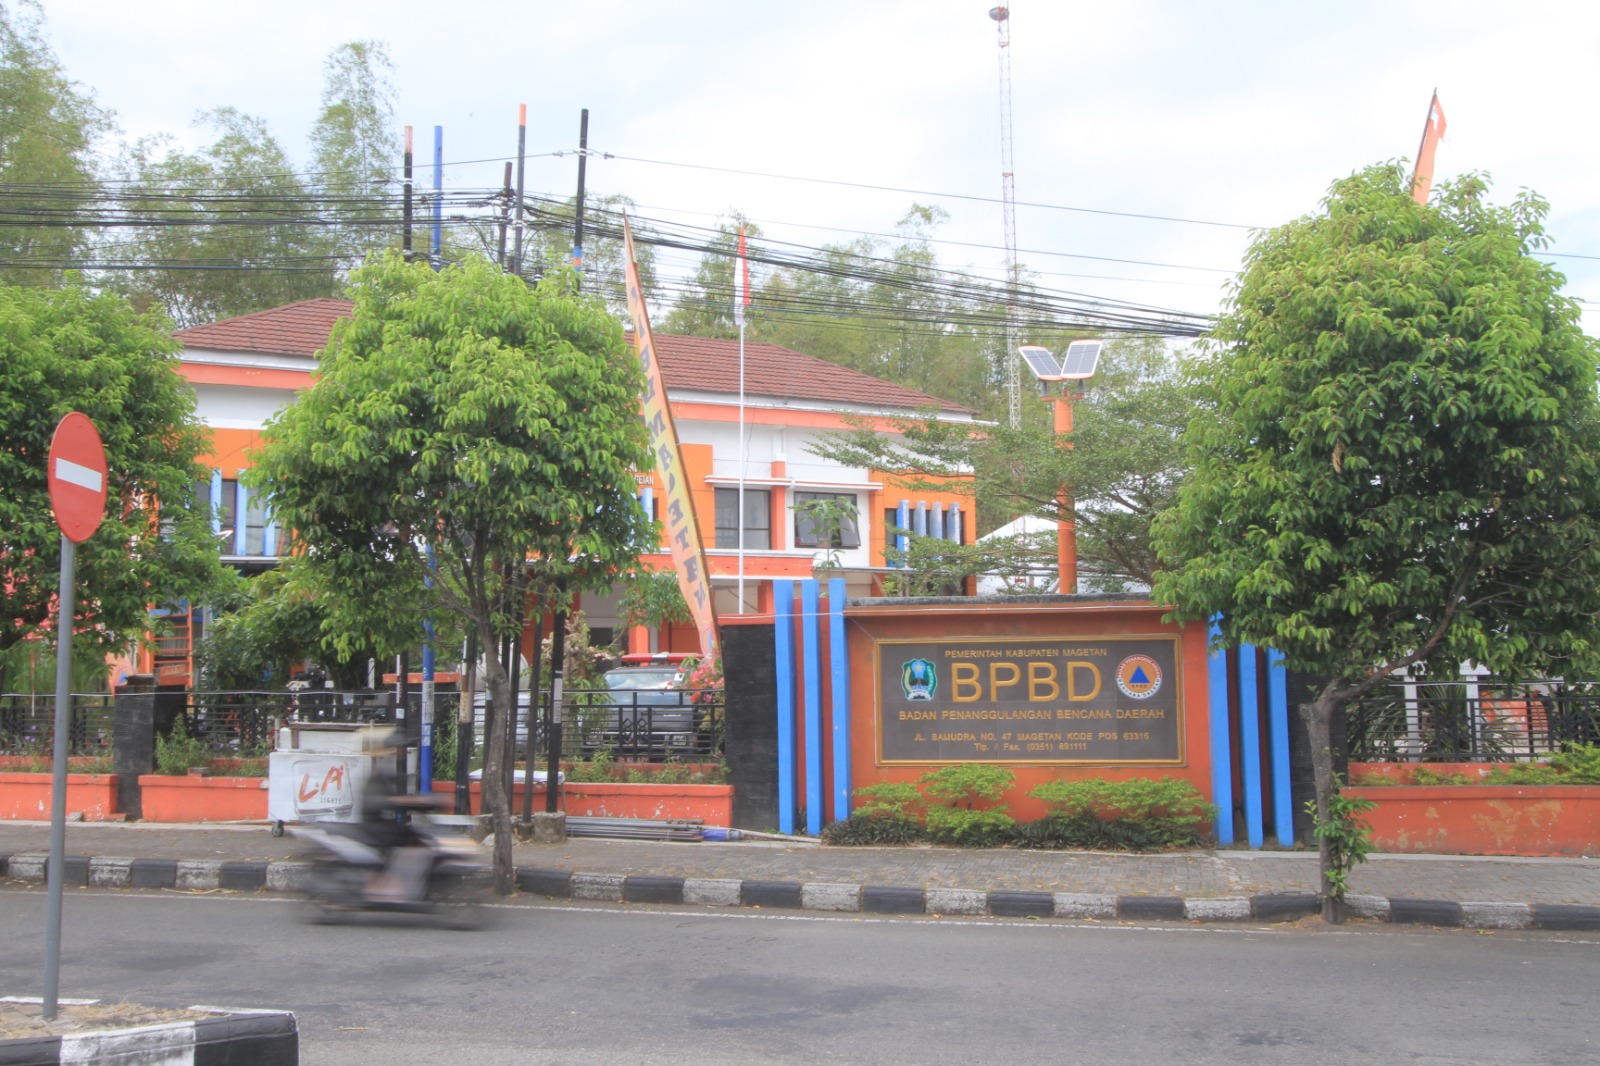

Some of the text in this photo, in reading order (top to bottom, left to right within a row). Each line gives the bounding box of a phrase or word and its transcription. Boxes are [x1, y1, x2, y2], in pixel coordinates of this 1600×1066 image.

[945, 648, 1107, 658] PEMERINTAH KABUPATEN MAGETAN
[951, 661, 1102, 703] BPBD
[899, 709, 1164, 720] BADAN PENANGGULANGAN BENCANA DAERAH
[914, 733, 926, 741] JL.
[931, 733, 976, 741] SAMUDRA
[981, 733, 997, 741] NO.
[1001, 733, 1012, 741] 47
[1017, 733, 1061, 741] MAGETAN
[1066, 732, 1093, 740] KODE
[1098, 732, 1118, 740] POS
[1027, 743, 1054, 752] (0351)
